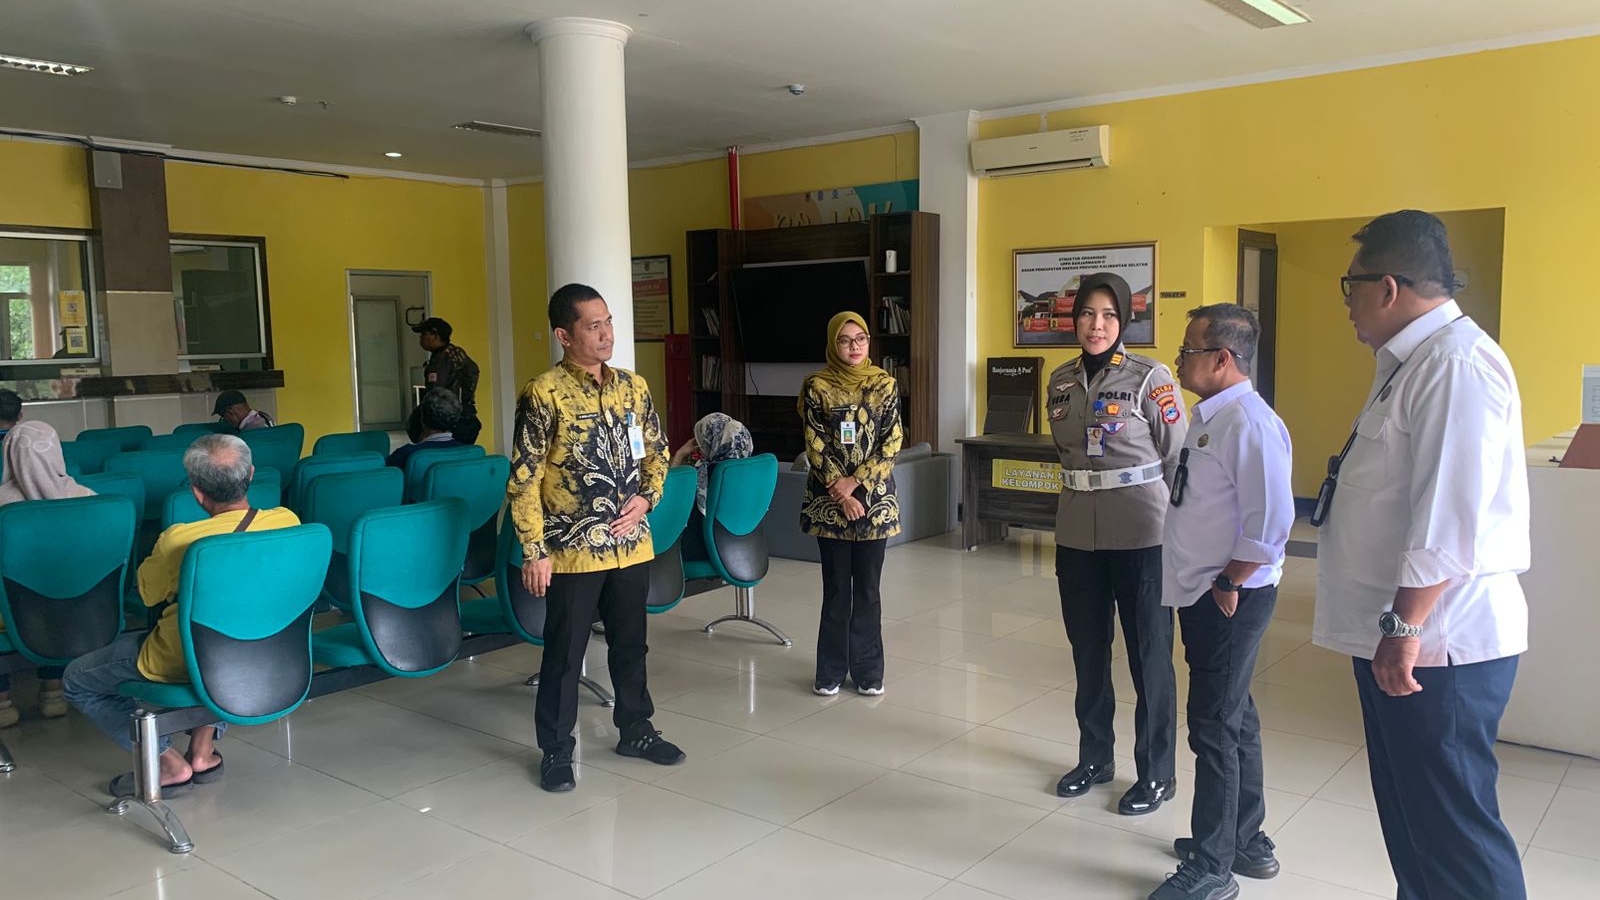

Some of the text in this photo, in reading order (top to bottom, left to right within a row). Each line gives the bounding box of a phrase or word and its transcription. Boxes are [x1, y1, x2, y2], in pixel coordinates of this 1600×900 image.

[1098, 392, 1131, 402] POLRI
[1005, 469, 1054, 480] LAYANAN
[1002, 479, 1059, 490] KELOMPOK
